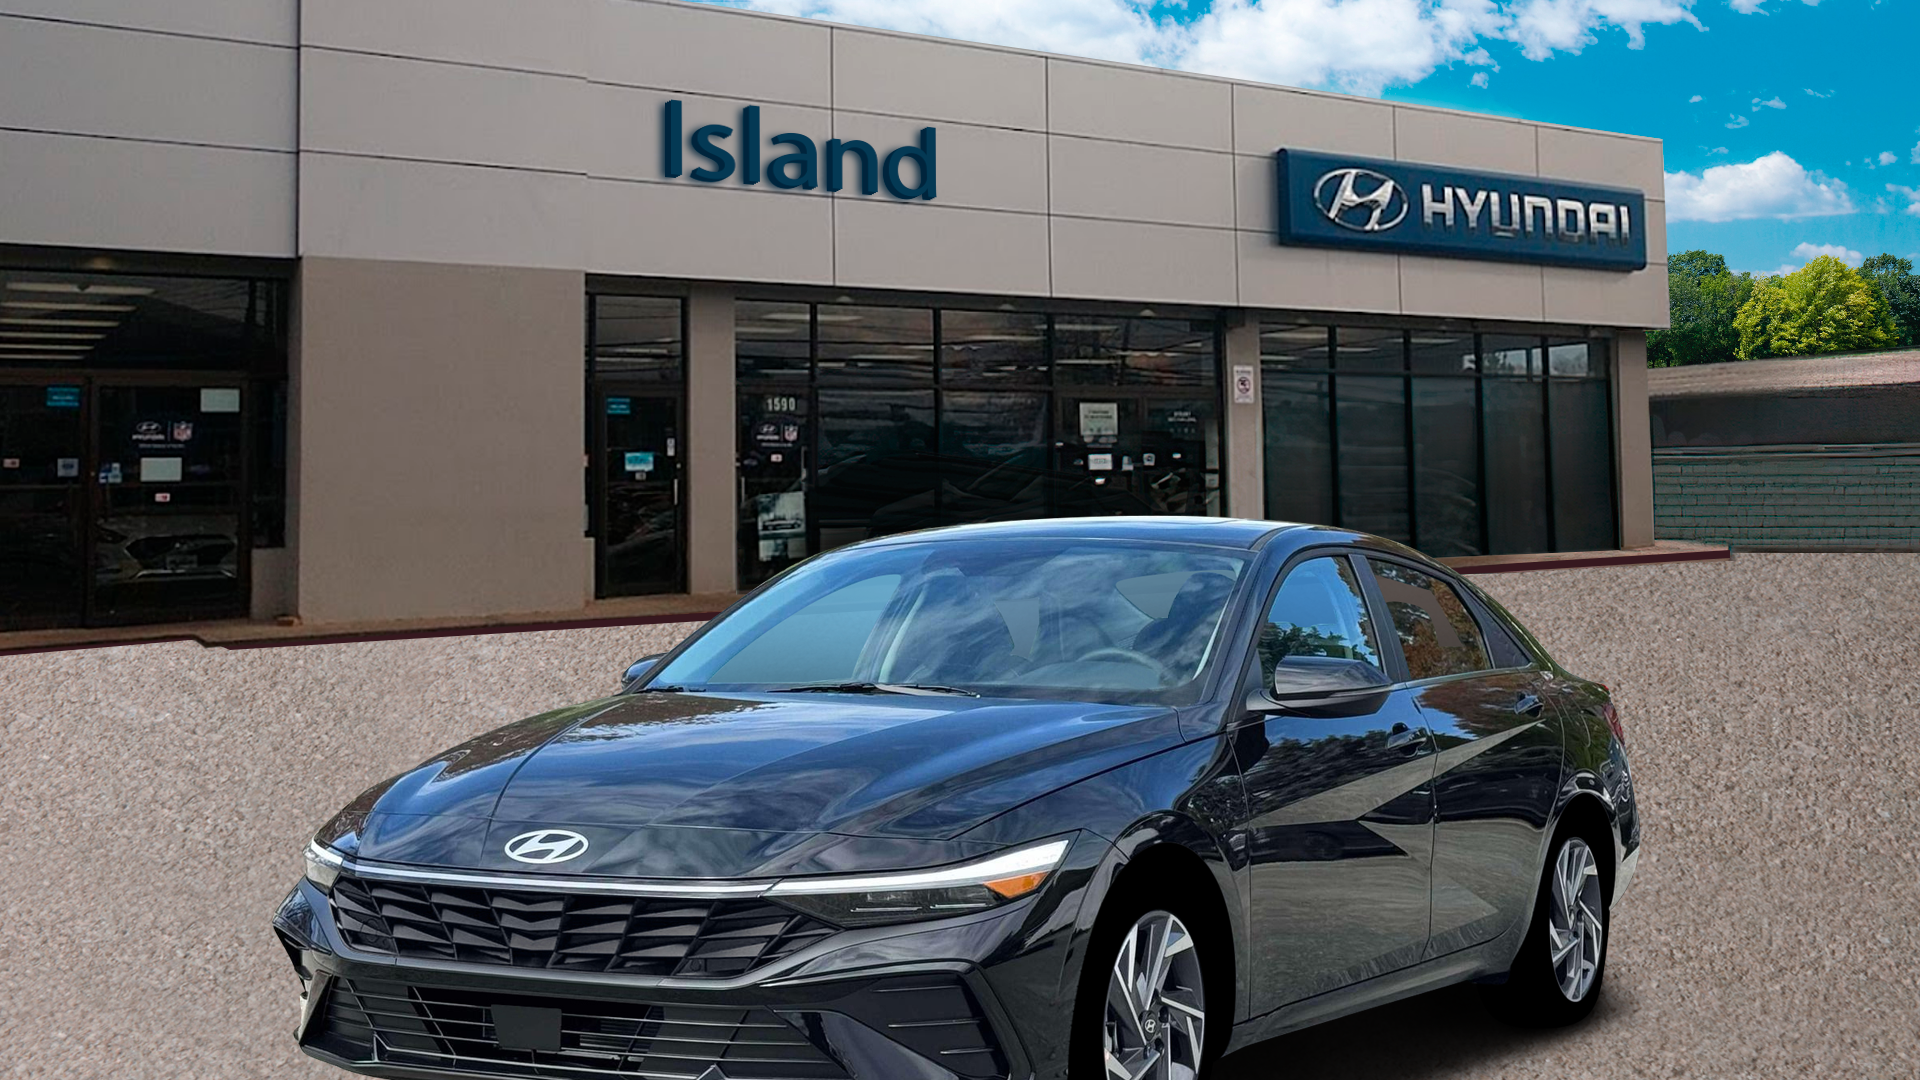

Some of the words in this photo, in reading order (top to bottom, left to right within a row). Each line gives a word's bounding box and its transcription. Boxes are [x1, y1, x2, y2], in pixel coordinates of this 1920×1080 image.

[663, 98, 938, 201] Island
[1421, 183, 1631, 246] HYUNDAI
[767, 397, 796, 412] 1590
